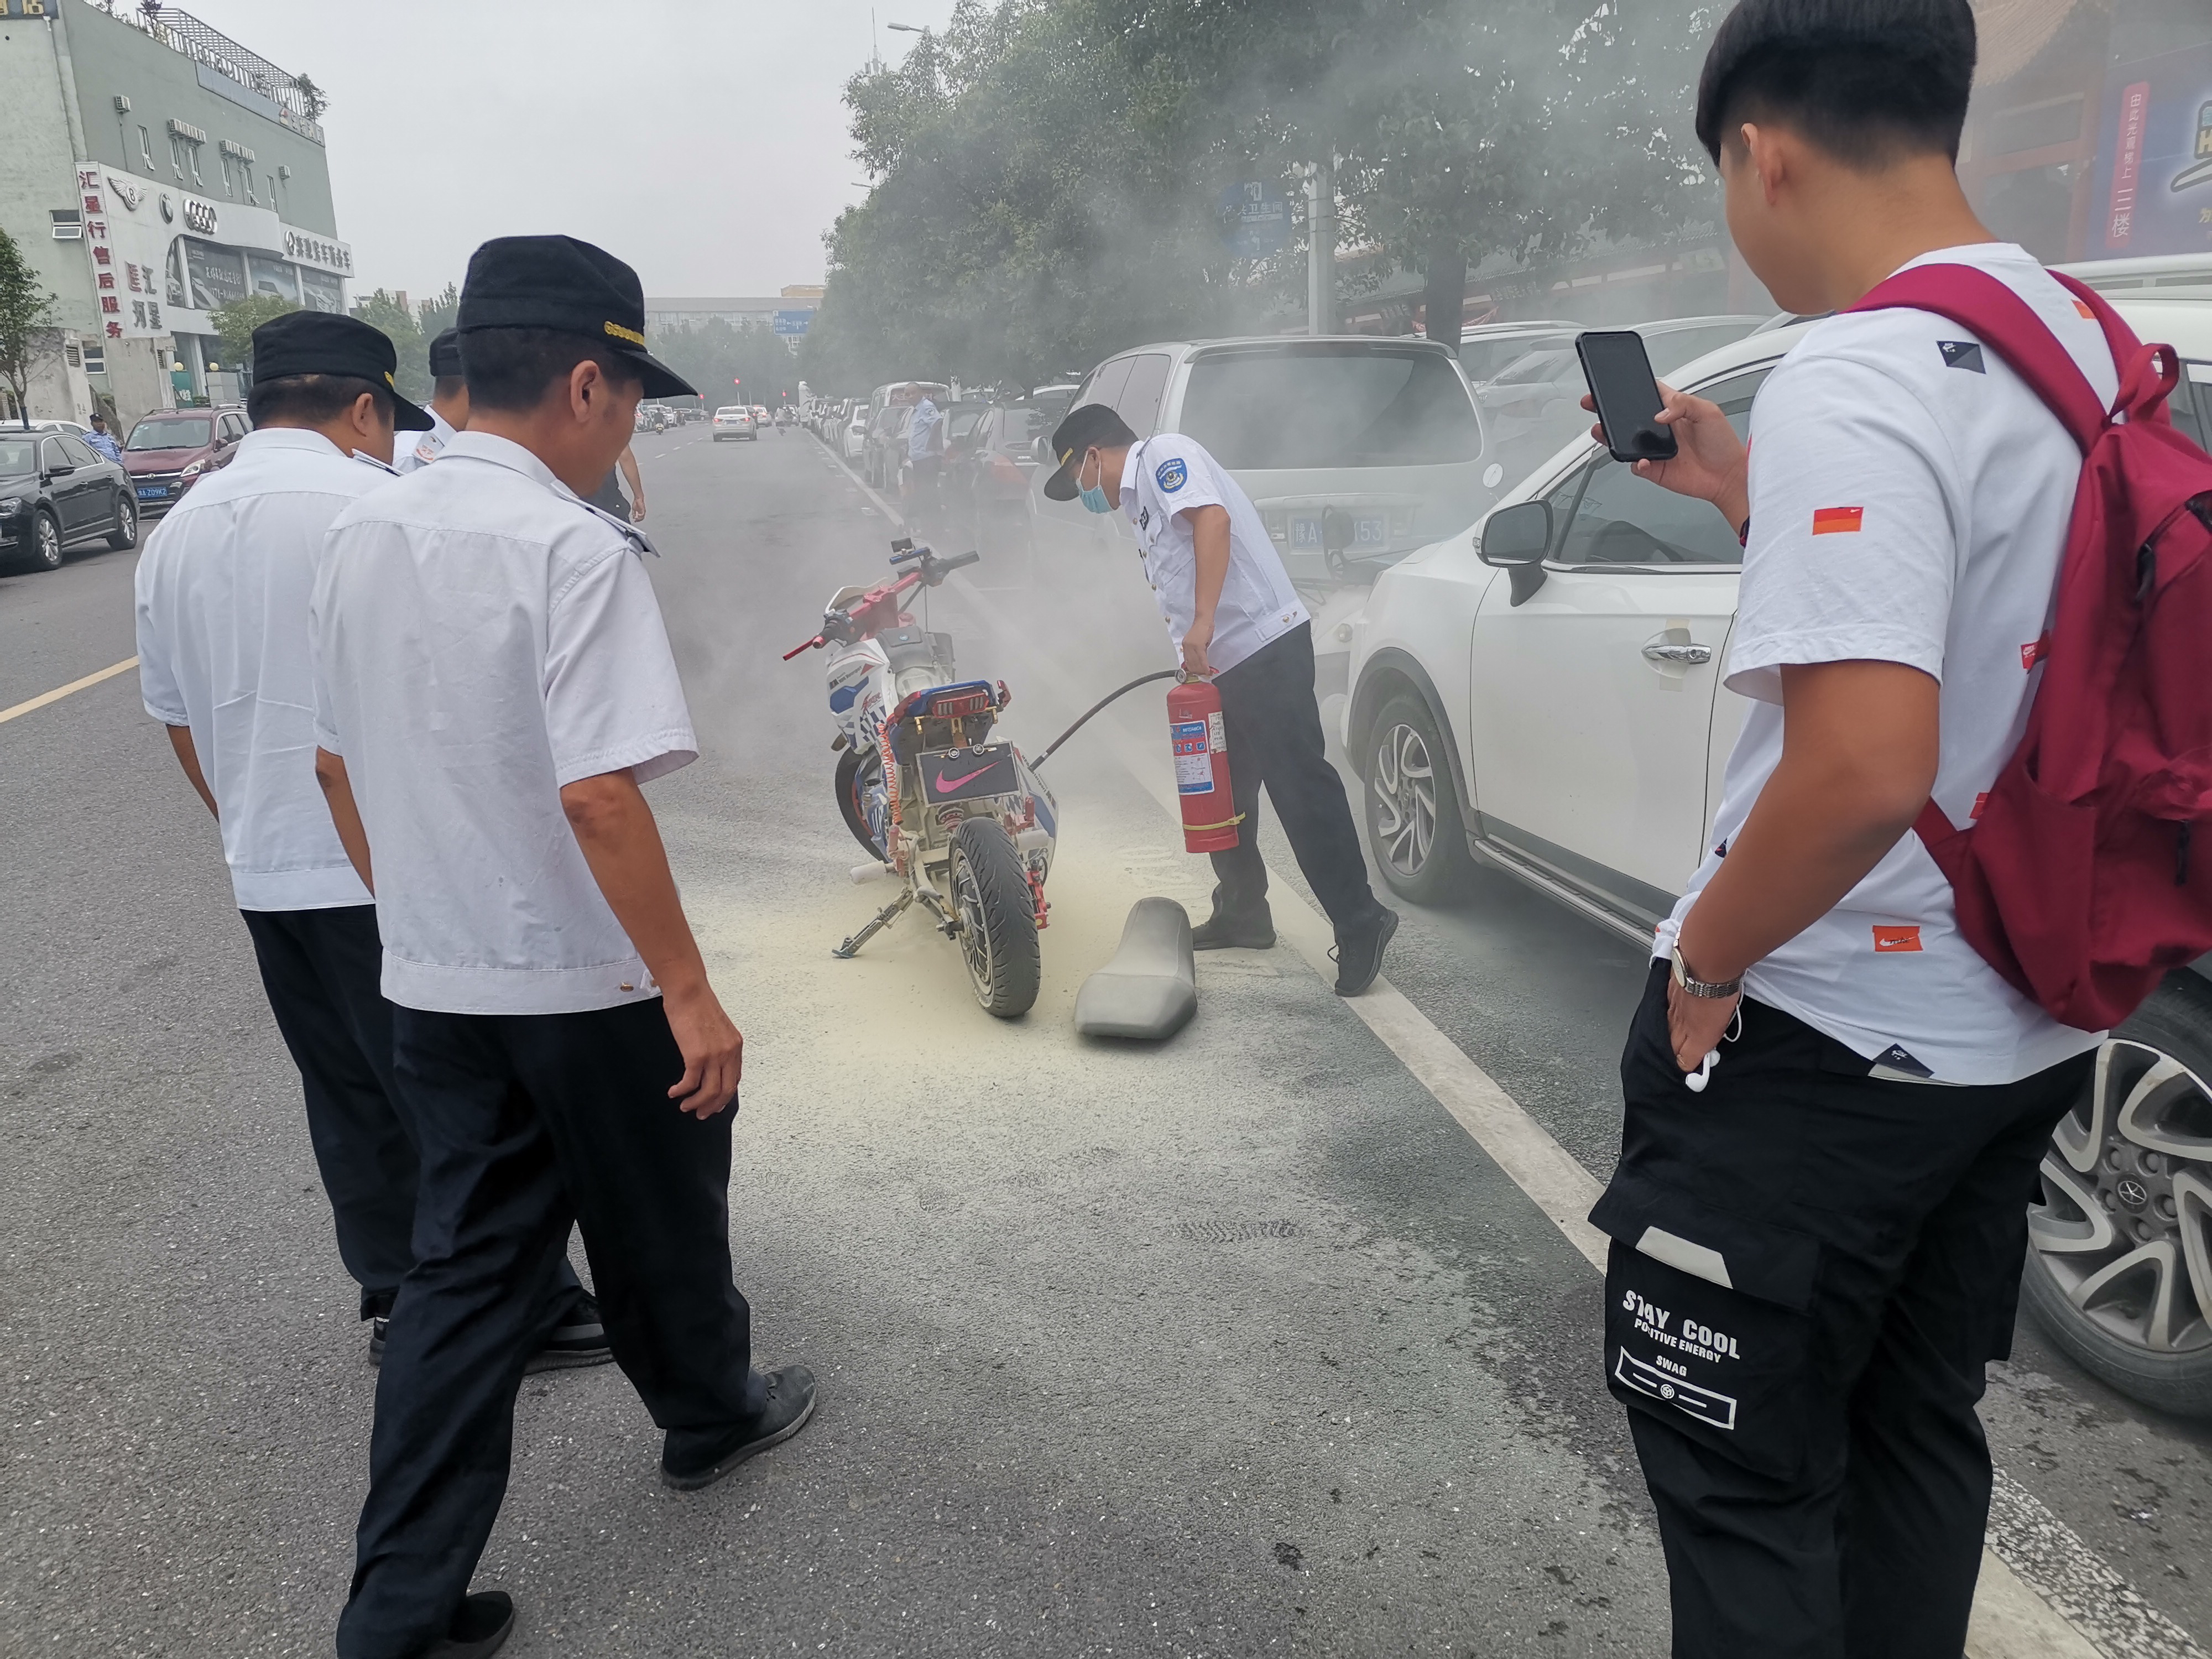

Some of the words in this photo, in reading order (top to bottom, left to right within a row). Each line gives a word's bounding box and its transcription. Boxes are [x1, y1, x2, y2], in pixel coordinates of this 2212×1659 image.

[79, 171, 123, 338] 汇星行售后服务
[1678, 1339, 1721, 1363] ENERGY
[1682, 1319, 1740, 1359] COOL
[1656, 1355, 1687, 1377] SWAG
